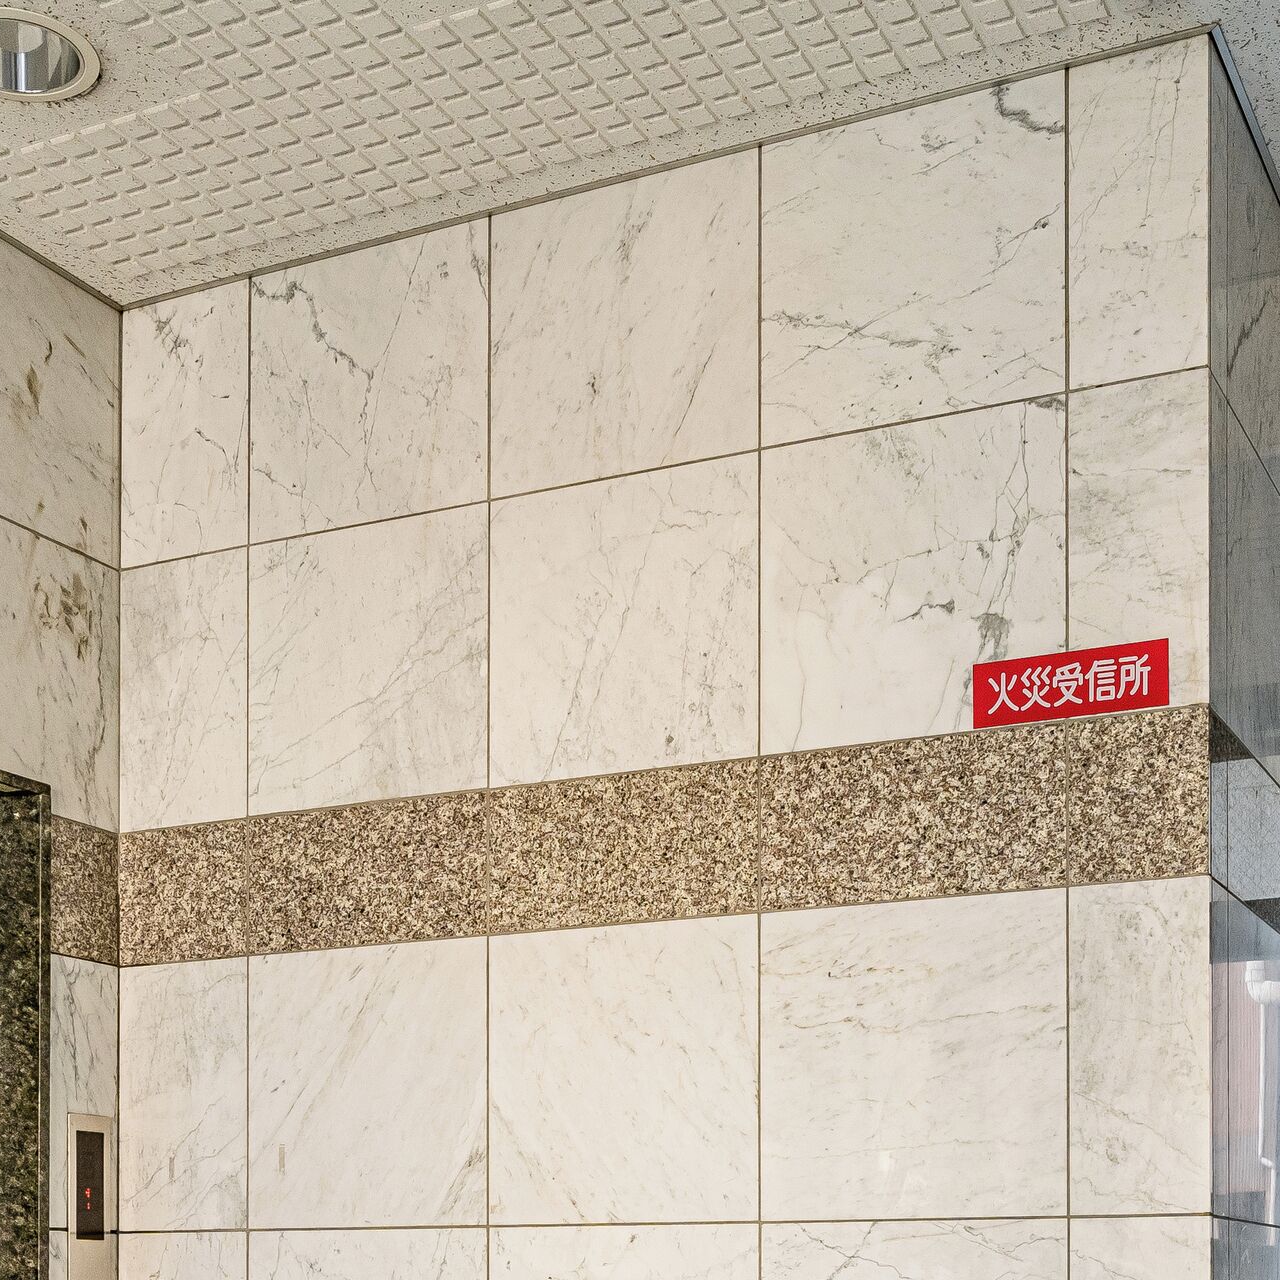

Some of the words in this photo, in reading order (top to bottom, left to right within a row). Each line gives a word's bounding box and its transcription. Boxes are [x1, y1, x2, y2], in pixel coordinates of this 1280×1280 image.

[987, 653, 1151, 715] 火災受信所
